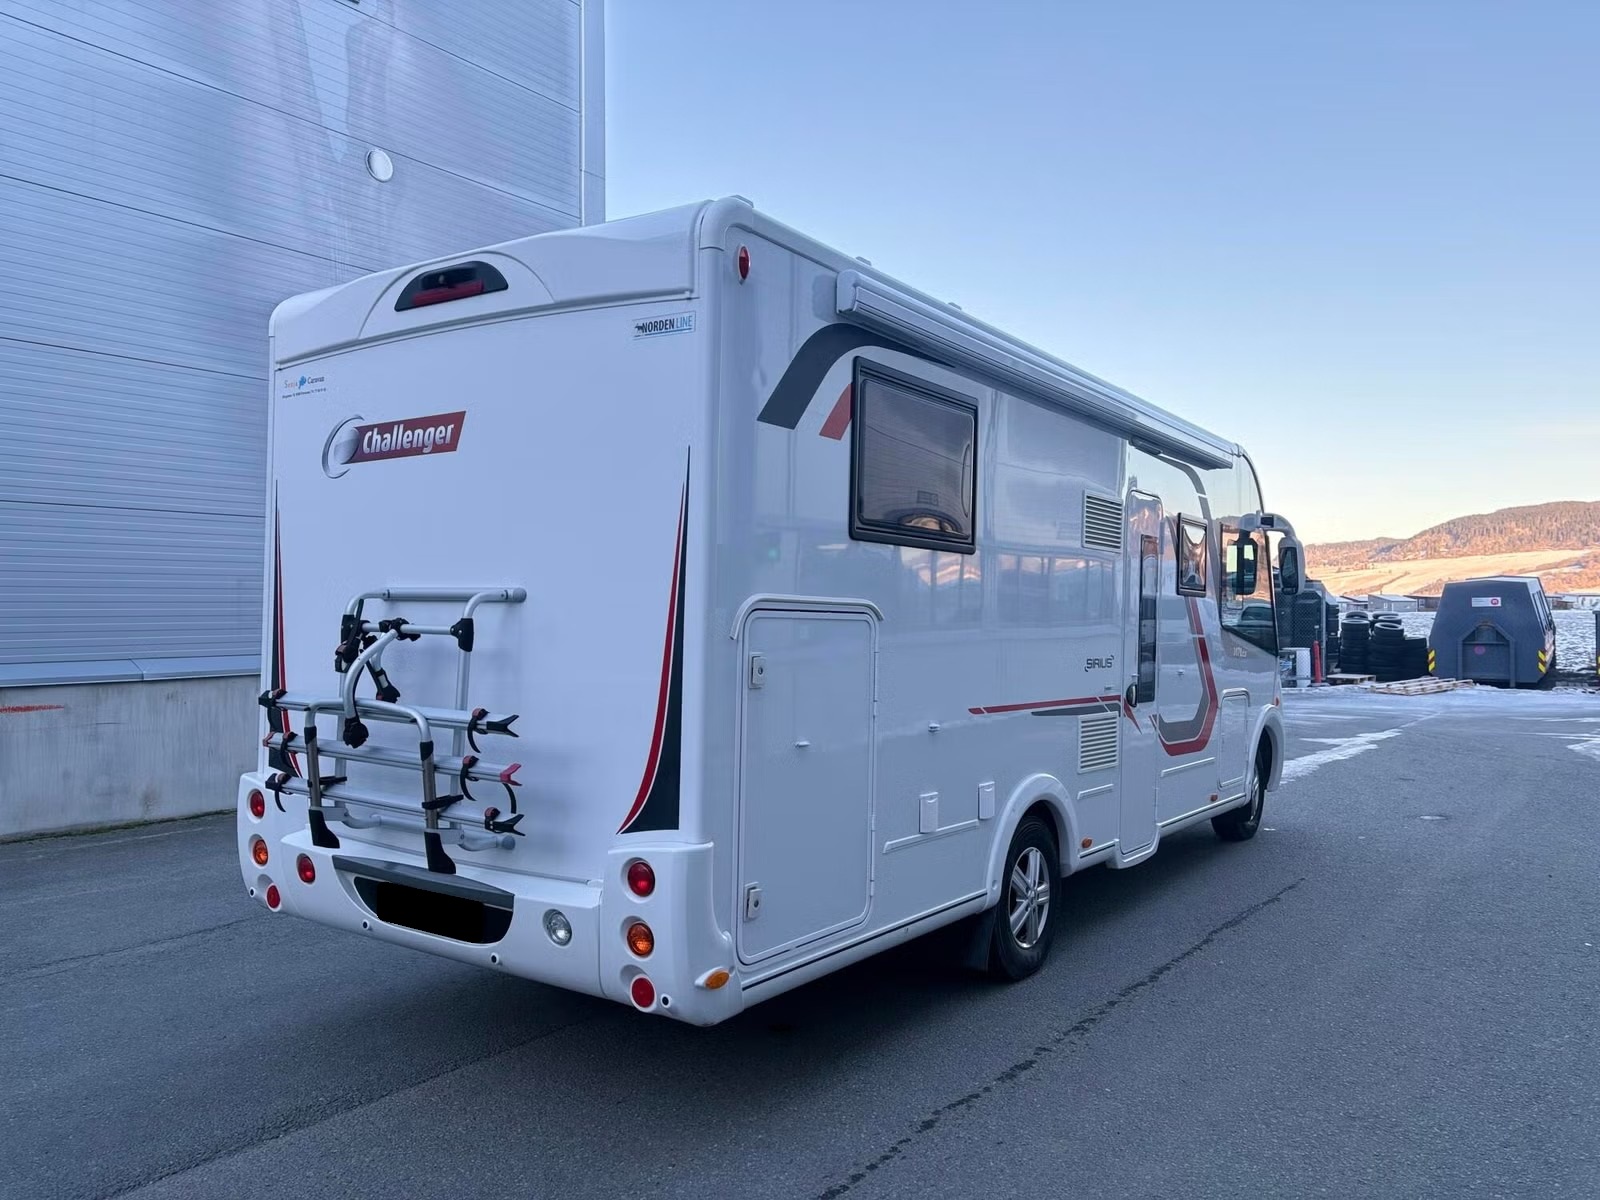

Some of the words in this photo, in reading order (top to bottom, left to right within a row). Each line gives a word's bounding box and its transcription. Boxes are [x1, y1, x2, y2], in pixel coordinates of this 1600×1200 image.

[642, 318, 675, 333] NORDEN
[676, 315, 693, 328] LINE
[362, 423, 455, 454] Challenger
[1085, 656, 1113, 670] SIRIUS
